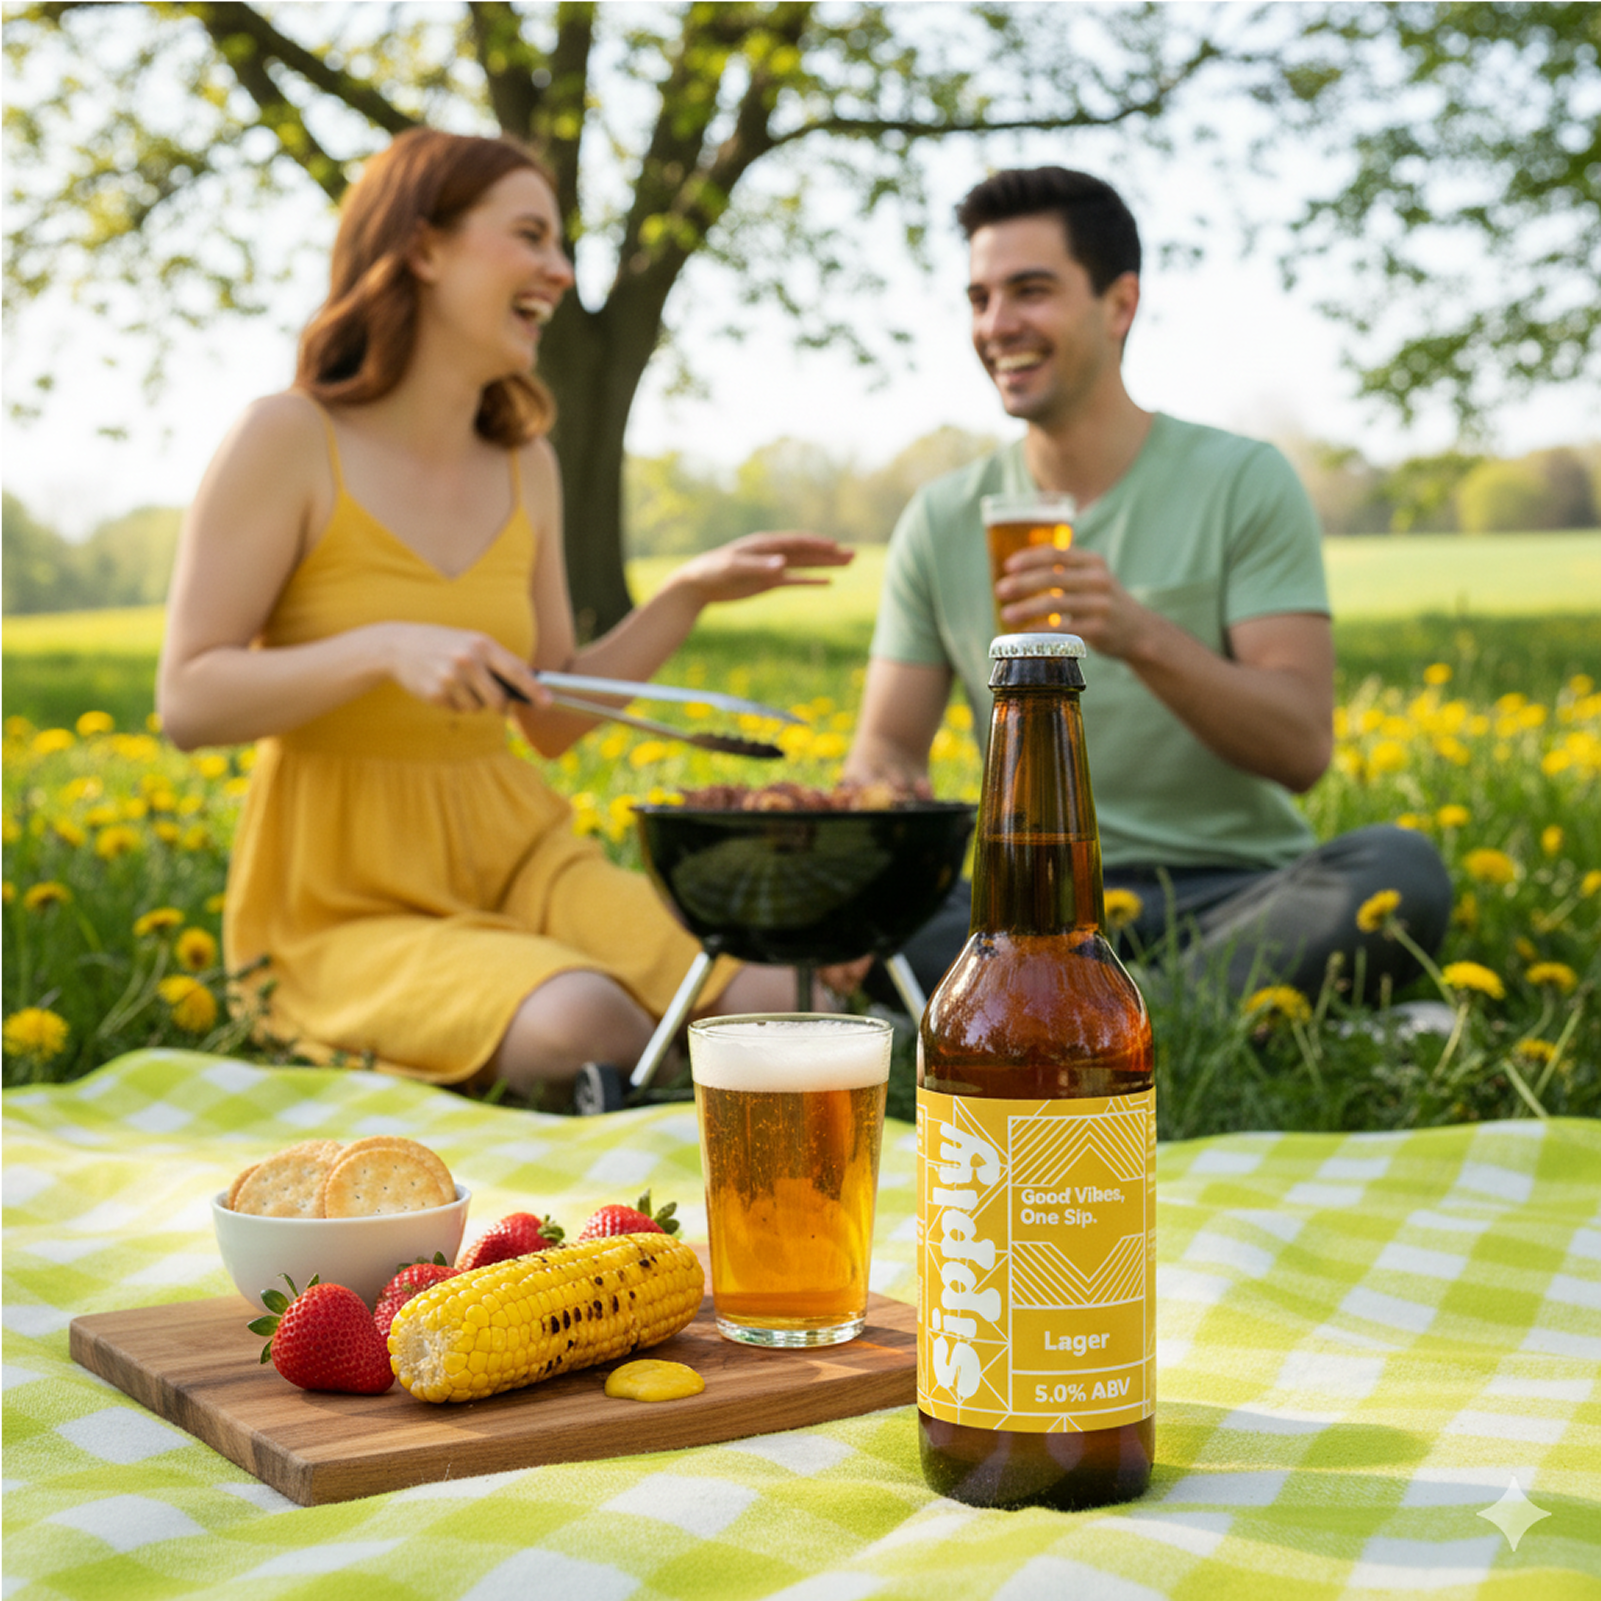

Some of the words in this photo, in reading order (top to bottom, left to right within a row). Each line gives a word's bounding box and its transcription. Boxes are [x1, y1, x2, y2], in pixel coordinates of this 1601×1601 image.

[1021, 1188, 1071, 1205] Good
[1074, 1186, 1125, 1203] Vibes,
[1020, 1208, 1060, 1225] One
[1064, 1208, 1098, 1229] Sip.
[932, 1121, 1001, 1399] Sipply
[1044, 1331, 1110, 1357] Lager
[1035, 1383, 1087, 1404] 5.0%
[1091, 1376, 1131, 1400] ABV
